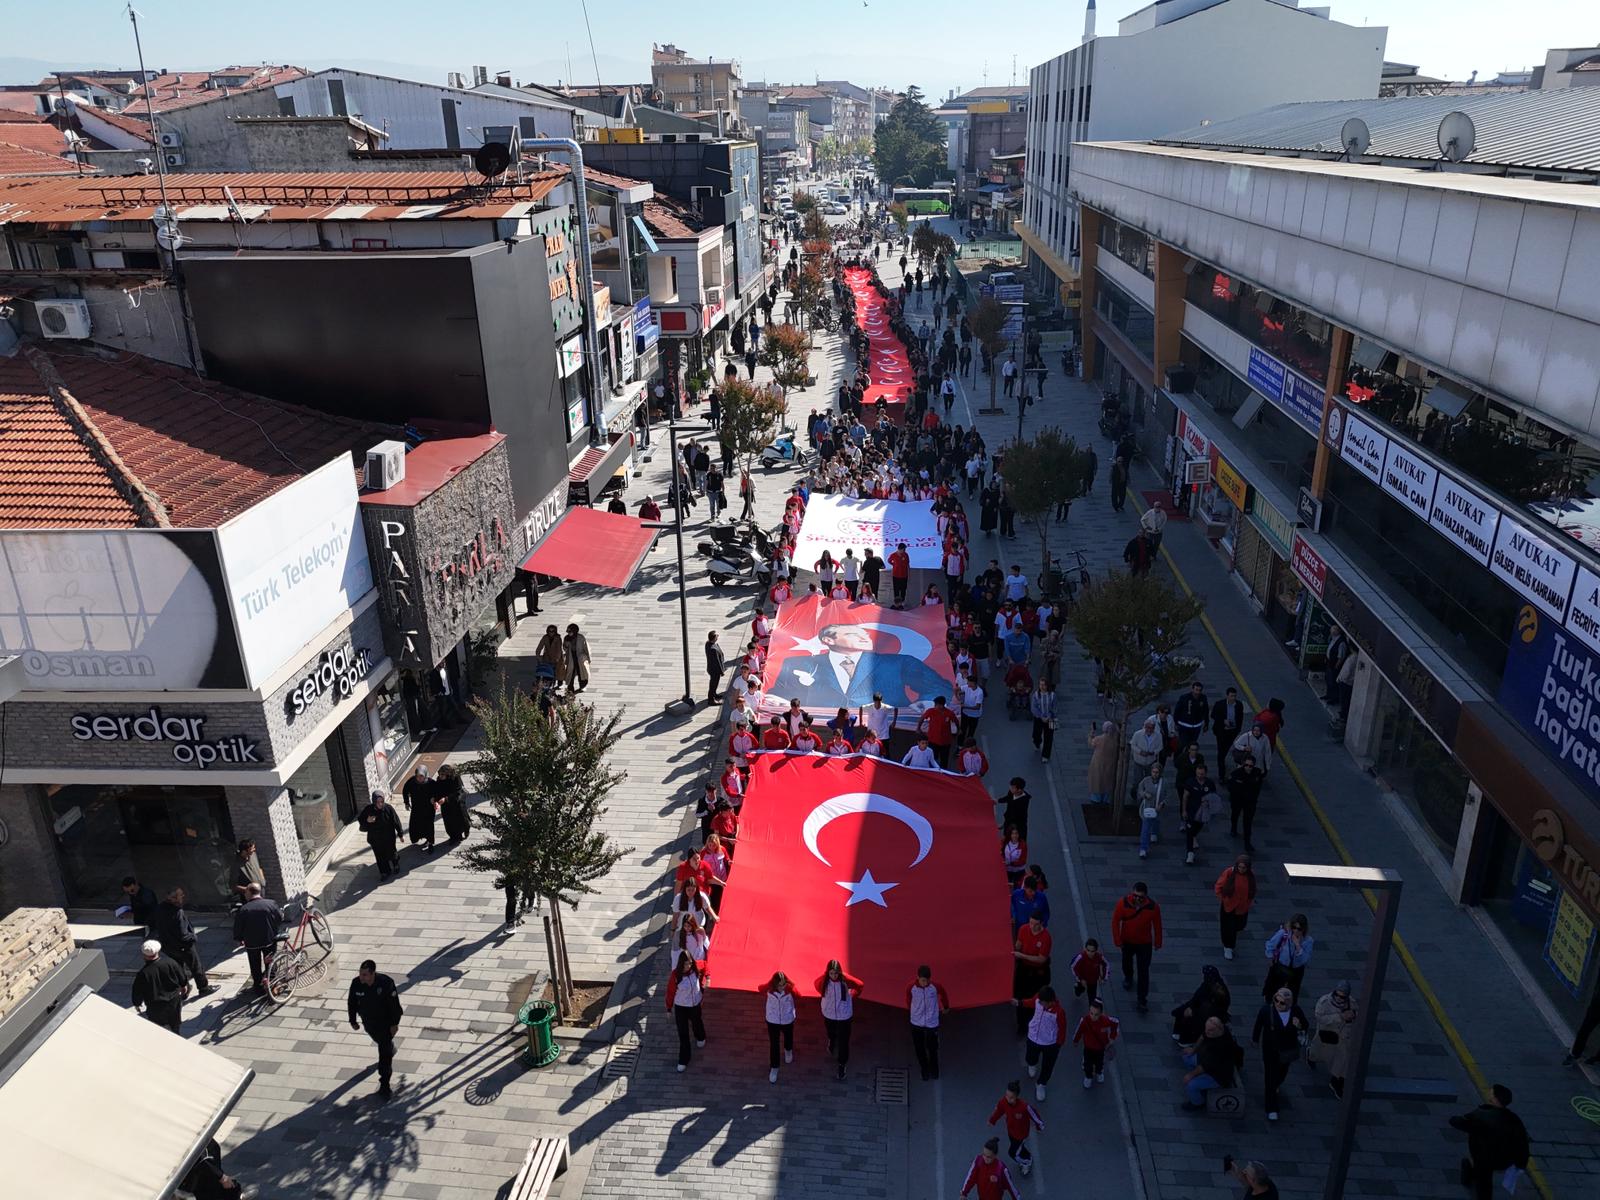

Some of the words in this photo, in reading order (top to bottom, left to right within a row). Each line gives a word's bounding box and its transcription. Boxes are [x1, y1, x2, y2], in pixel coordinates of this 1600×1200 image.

[1347, 420, 1366, 450] İsmail
[1367, 439, 1380, 461] Can
[1393, 454, 1427, 485] AVUKAT
[1385, 470, 1409, 495] İSMAİL
[1410, 489, 1427, 511] CAN
[1444, 489, 1486, 526] AVUKAT
[525, 491, 562, 551] FİRUZE
[1433, 507, 1444, 523] ATA
[1443, 514, 1464, 540] HAZAR
[1464, 530, 1489, 558] ÇINARLI
[1300, 545, 1320, 573] DÜZCE
[1509, 532, 1561, 577] AVUKAT
[241, 578, 281, 620] Türk
[281, 534, 344, 590] Telekom
[1299, 561, 1323, 595] MERKEZİ
[1494, 549, 1515, 576] GÜLSER
[1515, 568, 1531, 588] MELİS
[1530, 577, 1566, 613] KAHRAMAN
[1571, 607, 1600, 640] FECRİYE
[23, 650, 155, 677] Osman
[292, 643, 350, 715] serdar
[340, 649, 373, 695] optik
[71, 709, 204, 741] serdar
[173, 738, 259, 769] optik
